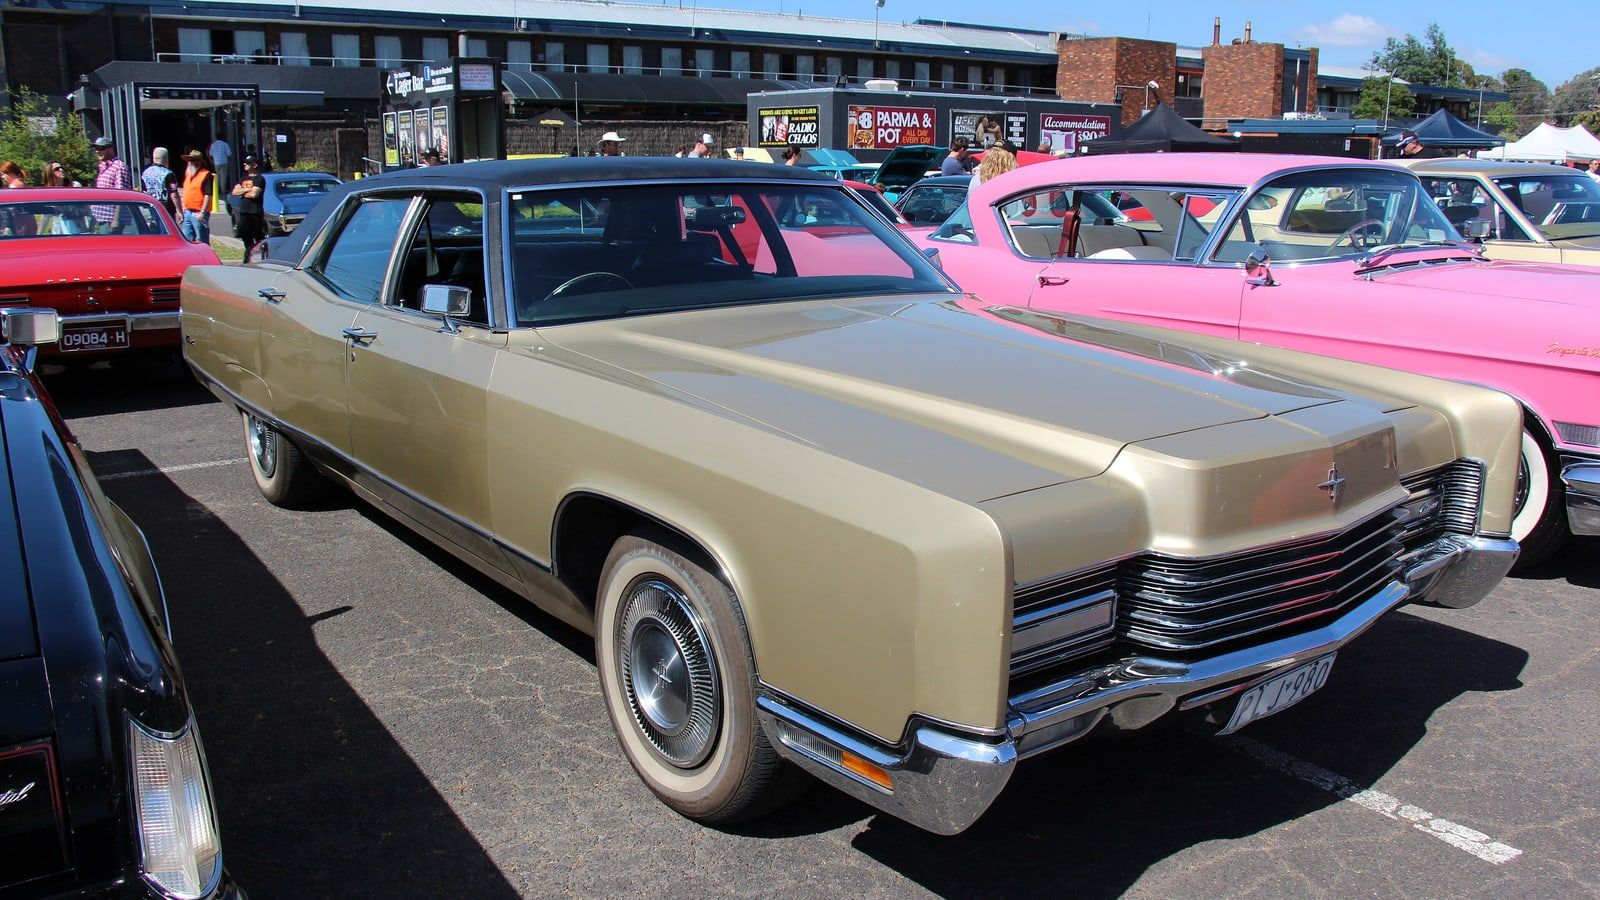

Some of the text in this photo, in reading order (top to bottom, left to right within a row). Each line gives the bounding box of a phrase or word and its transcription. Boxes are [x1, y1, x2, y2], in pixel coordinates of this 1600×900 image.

[394, 77, 412, 98] Lager
[412, 75, 424, 92] Bar
[877, 111, 919, 128] PARMA
[922, 112, 932, 129] &
[1044, 116, 1106, 130] Accommodation
[788, 122, 817, 133] RADIO
[906, 129, 929, 137] ALL DAY
[954, 124, 976, 134] BOXING
[788, 133, 818, 144] CHAOS
[877, 128, 901, 144] POT
[902, 136, 919, 144] EVERY
